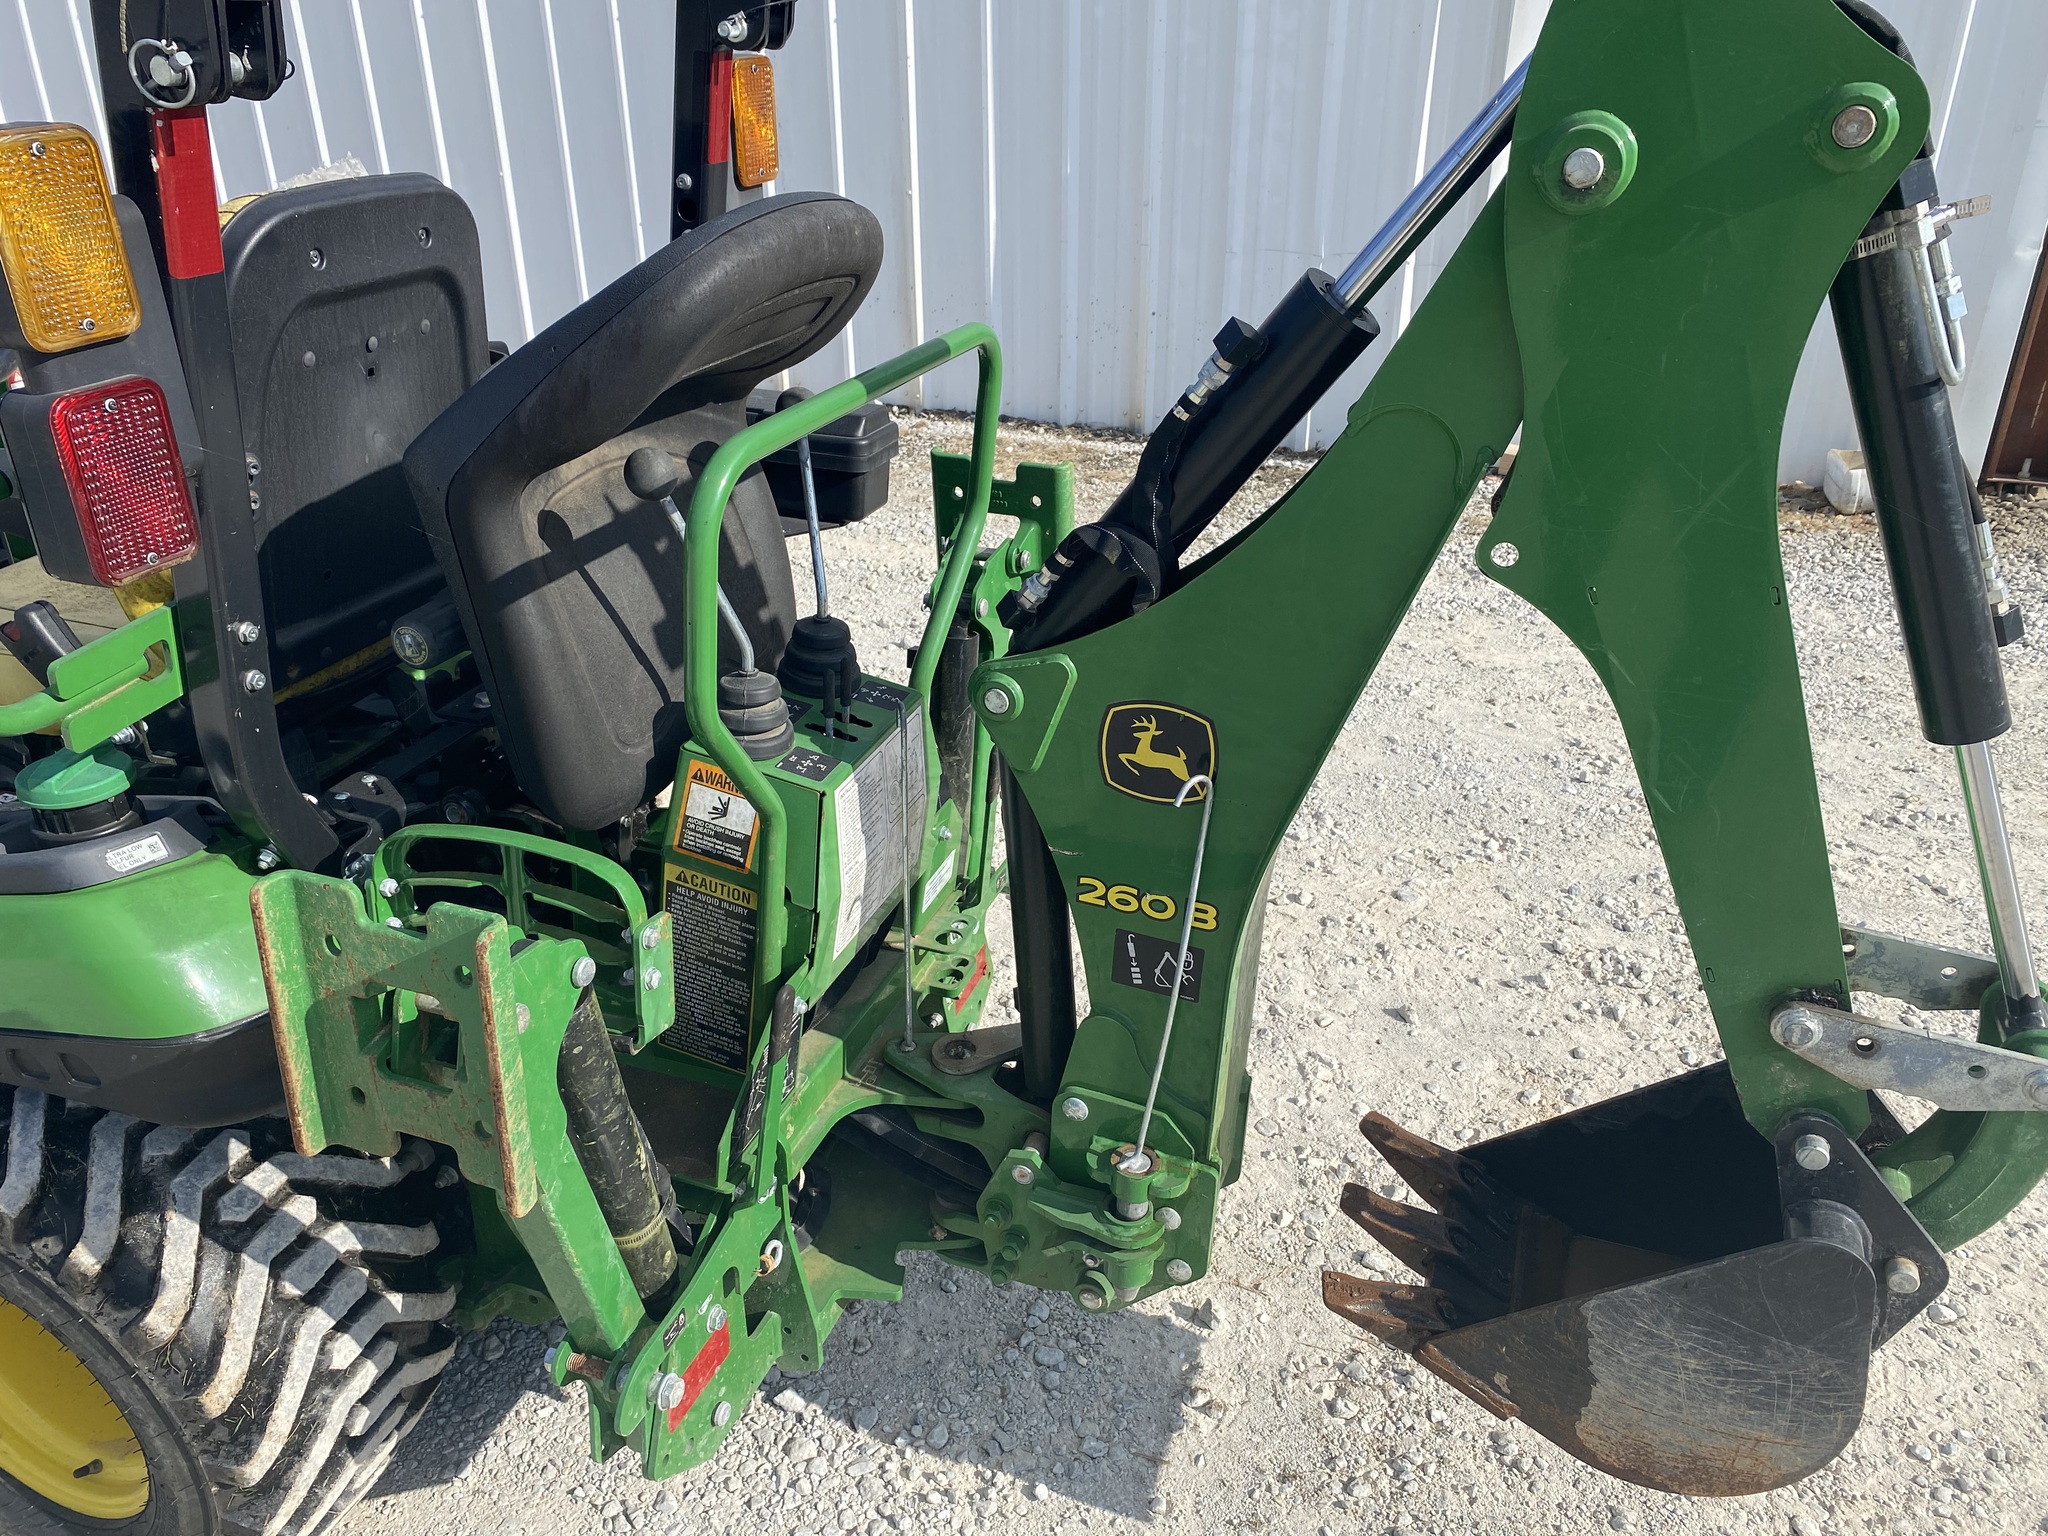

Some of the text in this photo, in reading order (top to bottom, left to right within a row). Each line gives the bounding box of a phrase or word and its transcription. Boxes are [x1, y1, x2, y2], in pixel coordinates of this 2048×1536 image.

[687, 817, 745, 840] AVOID CRUSH INJURY
[695, 825, 715, 836] DEATH
[127, 843, 143, 853] LOW
[110, 853, 135, 866] ULFUR
[128, 855, 147, 866] ONLY
[690, 874, 751, 905] CAUTION
[676, 886, 748, 916] HELP AVOID INJURY
[1078, 877, 1218, 931] 260 B
